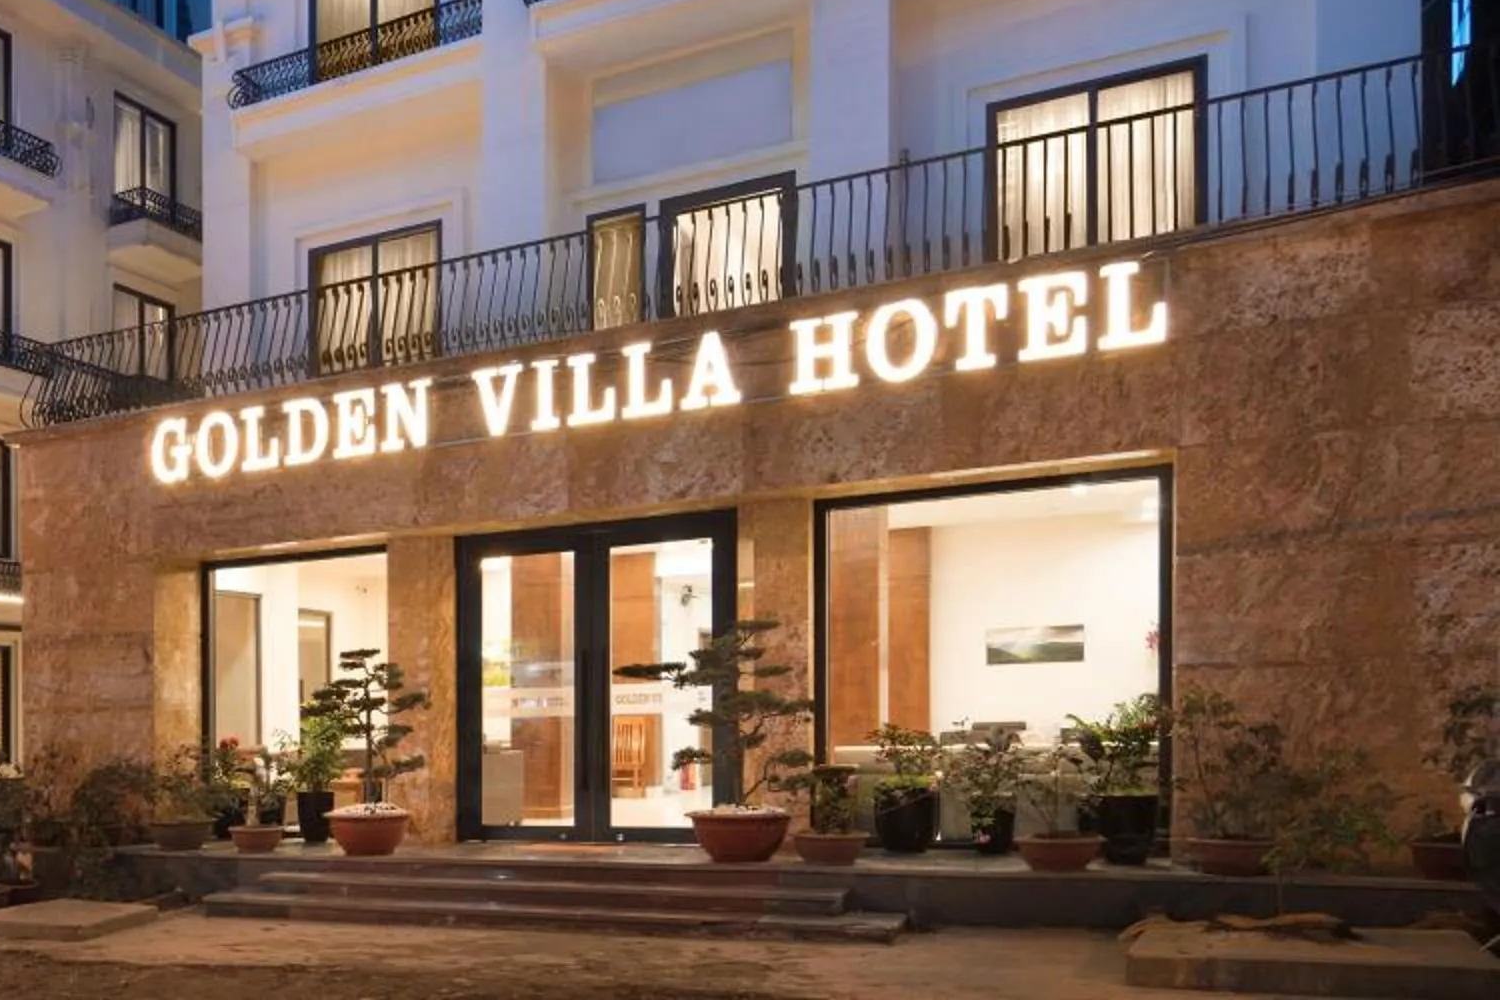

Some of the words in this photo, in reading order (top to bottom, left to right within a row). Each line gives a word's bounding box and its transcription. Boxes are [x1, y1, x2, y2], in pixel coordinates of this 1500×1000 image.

[149, 378, 433, 485] GOLDEN
[470, 330, 743, 438] VILLA
[787, 260, 1169, 396] HOTEL
